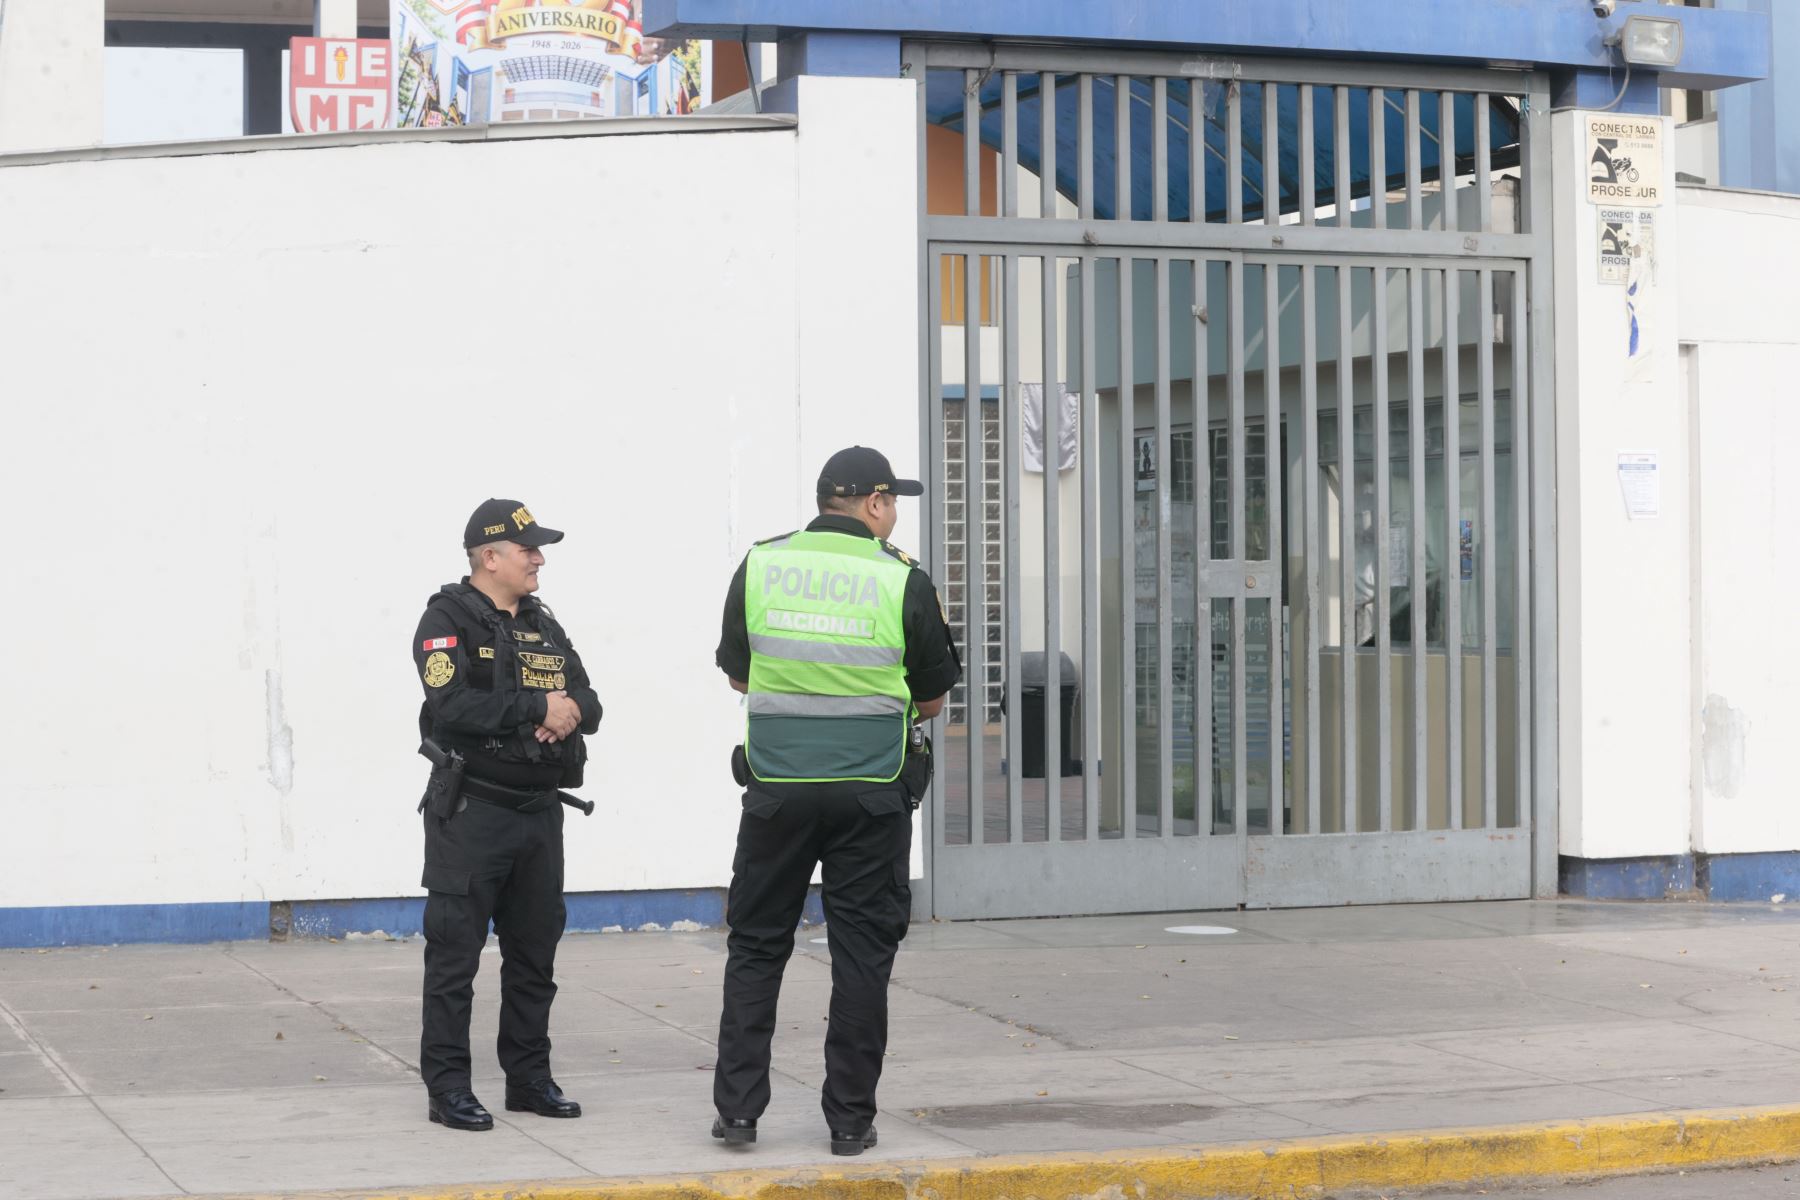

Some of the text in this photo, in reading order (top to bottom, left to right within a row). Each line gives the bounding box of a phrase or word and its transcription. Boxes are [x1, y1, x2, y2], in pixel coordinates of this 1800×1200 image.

[497, 11, 617, 35] ANIVERSARIO
[530, 39, 581, 50] 1948 2026
[361, 47, 387, 77] E
[1591, 122, 1656, 135] CONECTADA
[1591, 185, 1657, 198] PROSEUR
[484, 524, 505, 535] PERU
[764, 565, 880, 608] POLICIA
[767, 610, 874, 638] NACIONAL
